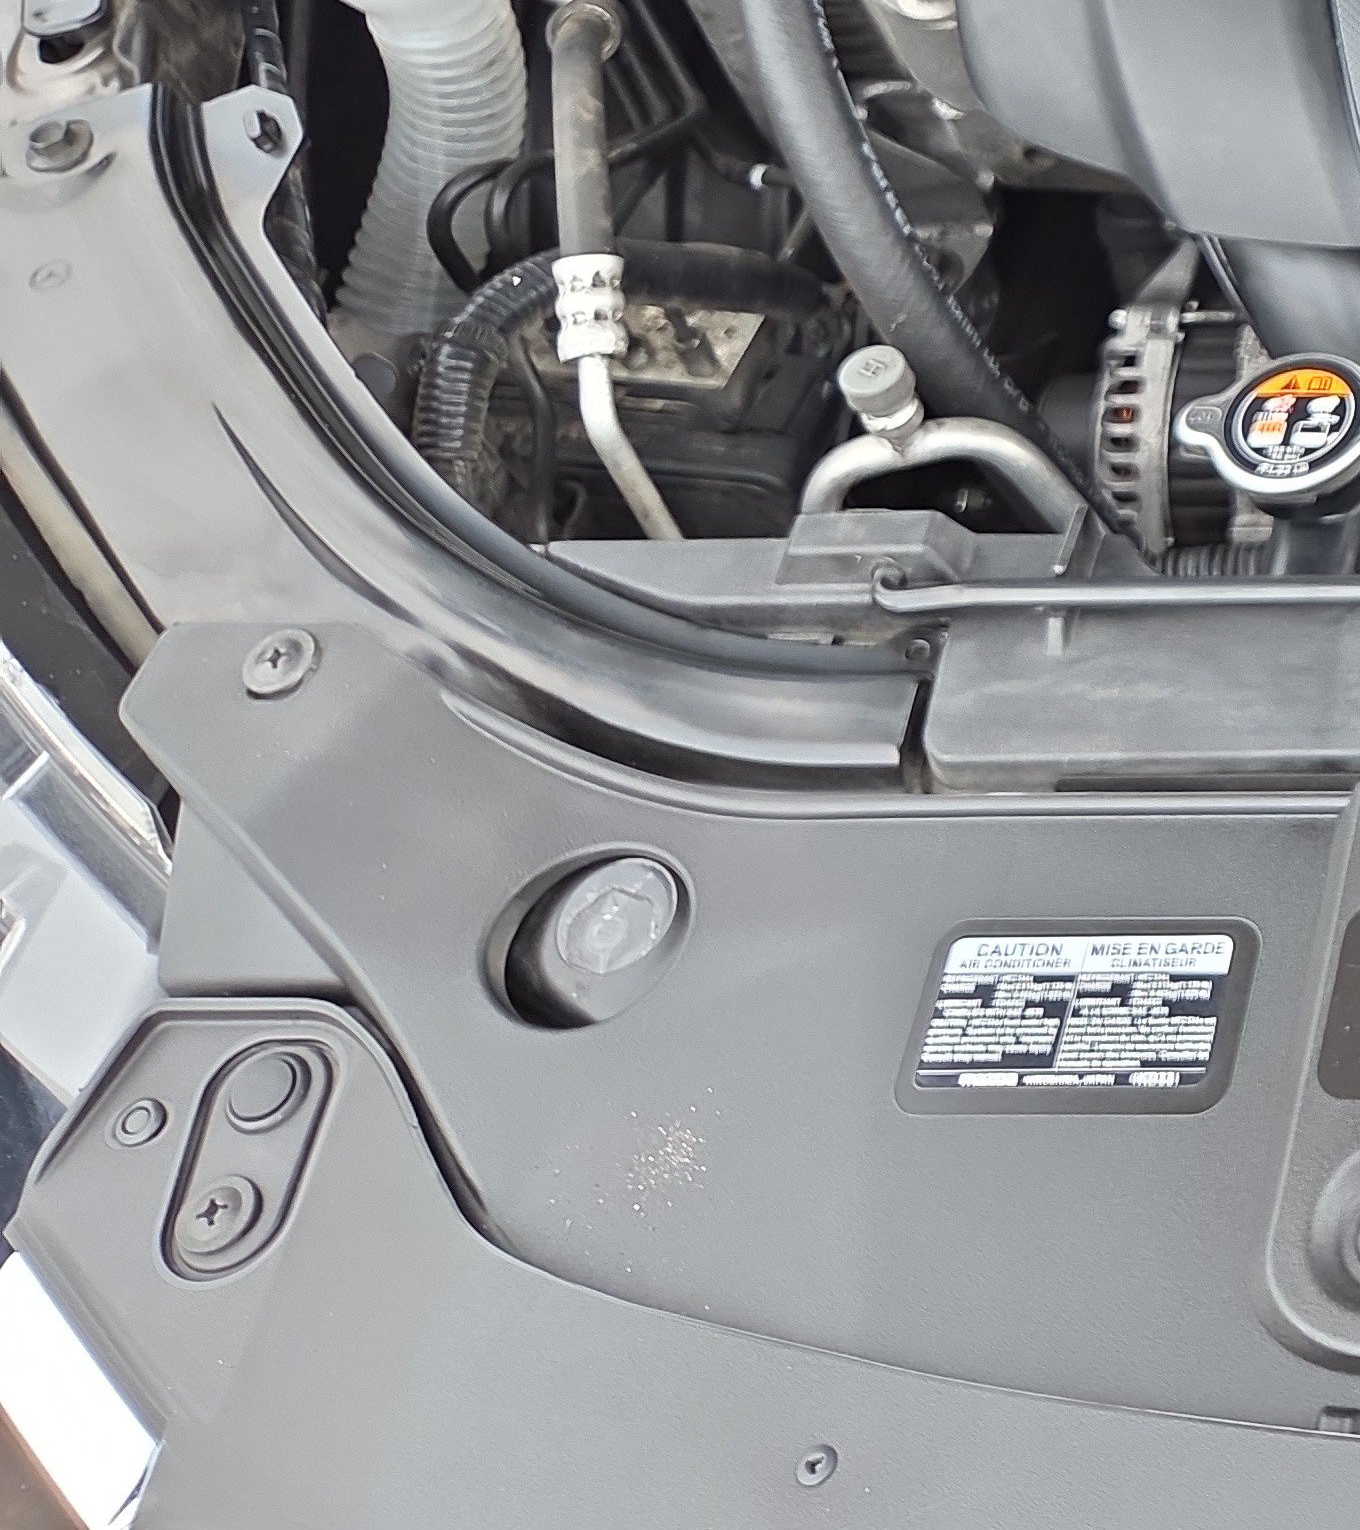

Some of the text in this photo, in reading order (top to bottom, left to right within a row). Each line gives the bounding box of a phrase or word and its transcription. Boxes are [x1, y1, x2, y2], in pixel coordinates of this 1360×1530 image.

[975, 942, 1064, 957] CAUTION
[1091, 941, 1226, 956] MISE EN GARDE
[958, 957, 1072, 969] AIR CONDITIONER
[1110, 957, 1197, 969] CLIMATISEUR
